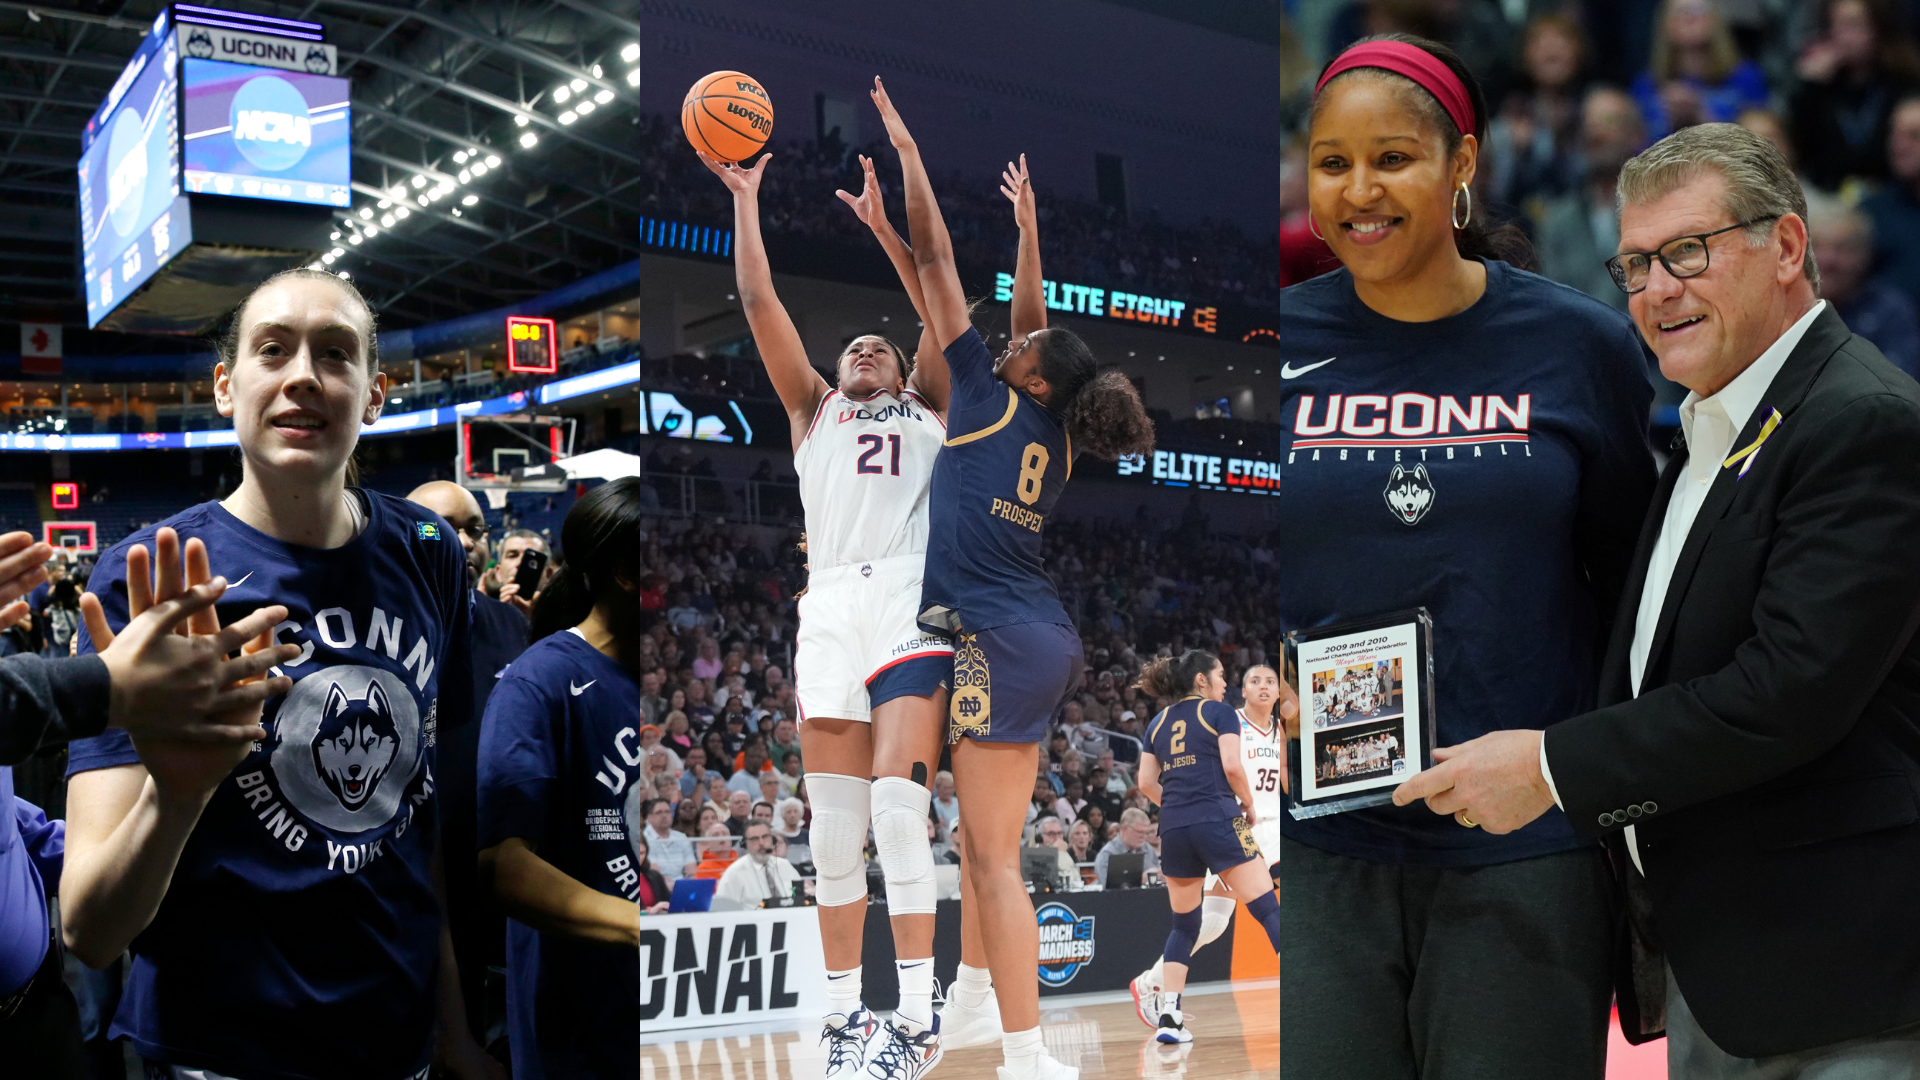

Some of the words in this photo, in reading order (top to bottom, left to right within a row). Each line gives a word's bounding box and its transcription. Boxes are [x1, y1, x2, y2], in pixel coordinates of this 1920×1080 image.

[221, 37, 297, 63] UCONN
[234, 110, 311, 147] NCAA
[727, 101, 771, 136] Wilson
[1109, 290, 1186, 327] EIGHT
[1294, 392, 1530, 436] UCONN
[857, 434, 901, 476] 21
[1153, 449, 1222, 484] ELITE
[1288, 444, 1531, 464] BASKETBALL
[1017, 442, 1050, 506] 8
[268, 606, 435, 691] CONN
[892, 636, 949, 655] HUSKIES
[1305, 655, 1330, 664] National
[1331, 647, 1373, 660] Championships
[1375, 641, 1407, 651] Celebration
[1324, 643, 1347, 653] 2009
[1349, 640, 1365, 649] and
[1367, 636, 1388, 646] 2010
[1335, 658, 1355, 666] Maya
[1357, 654, 1377, 662] Moore
[1171, 719, 1187, 755] 2
[1172, 754, 1197, 768] JESUS
[1255, 768, 1279, 792] 35
[236, 770, 308, 852] BRING
[326, 838, 383, 874] YOUR
[585, 816, 624, 825] BRIDGEPORT
[604, 808, 621, 816] NCAA
[588, 832, 625, 840] CHAMPIONS
[606, 854, 640, 905] BRI
[1038, 939, 1093, 960] MADNESS
